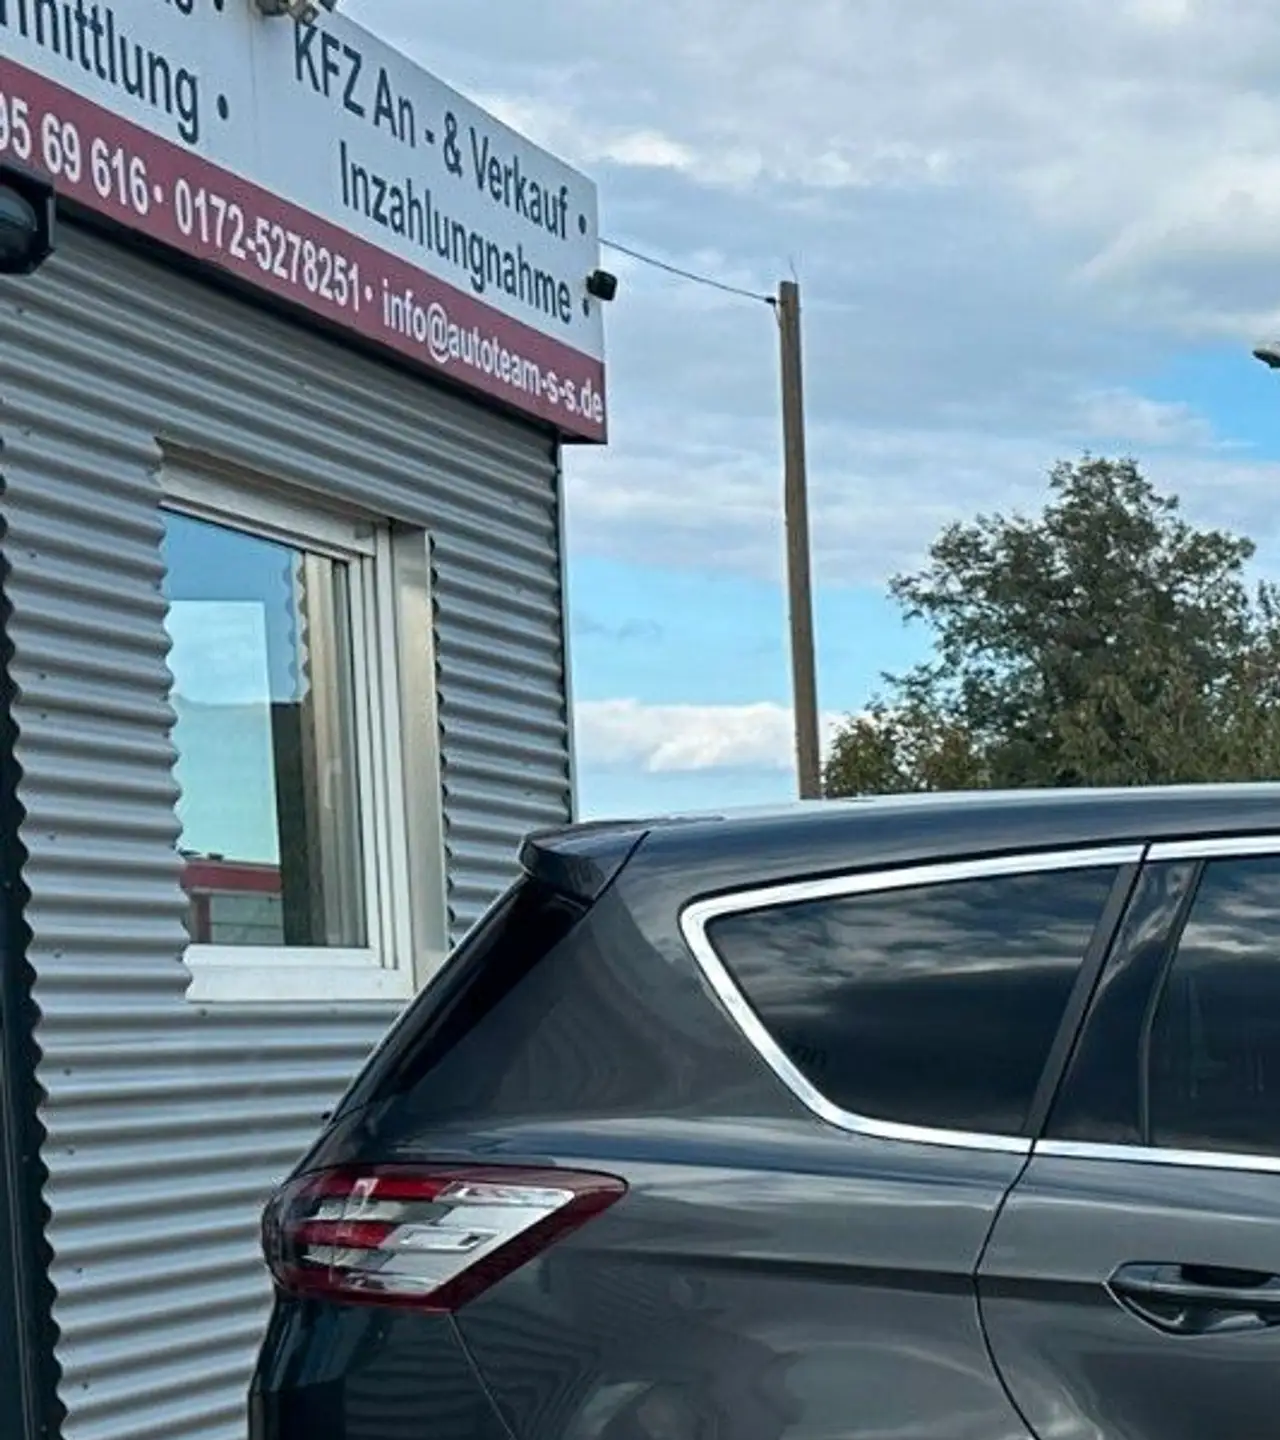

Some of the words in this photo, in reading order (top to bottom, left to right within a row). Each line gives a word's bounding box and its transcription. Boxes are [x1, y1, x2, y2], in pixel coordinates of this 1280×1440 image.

[0, 0, 200, 144] mittlung
[295, 19, 366, 119] KFZ
[443, 111, 463, 178] &
[470, 126, 569, 240] Verkauf
[42, 112, 81, 184] 69
[92, 137, 148, 216] 616
[175, 178, 360, 313] 0172-5278251
[383, 278, 605, 425] info@autoteam-s-s.de
[340, 139, 572, 324] Inzahlungnahme
